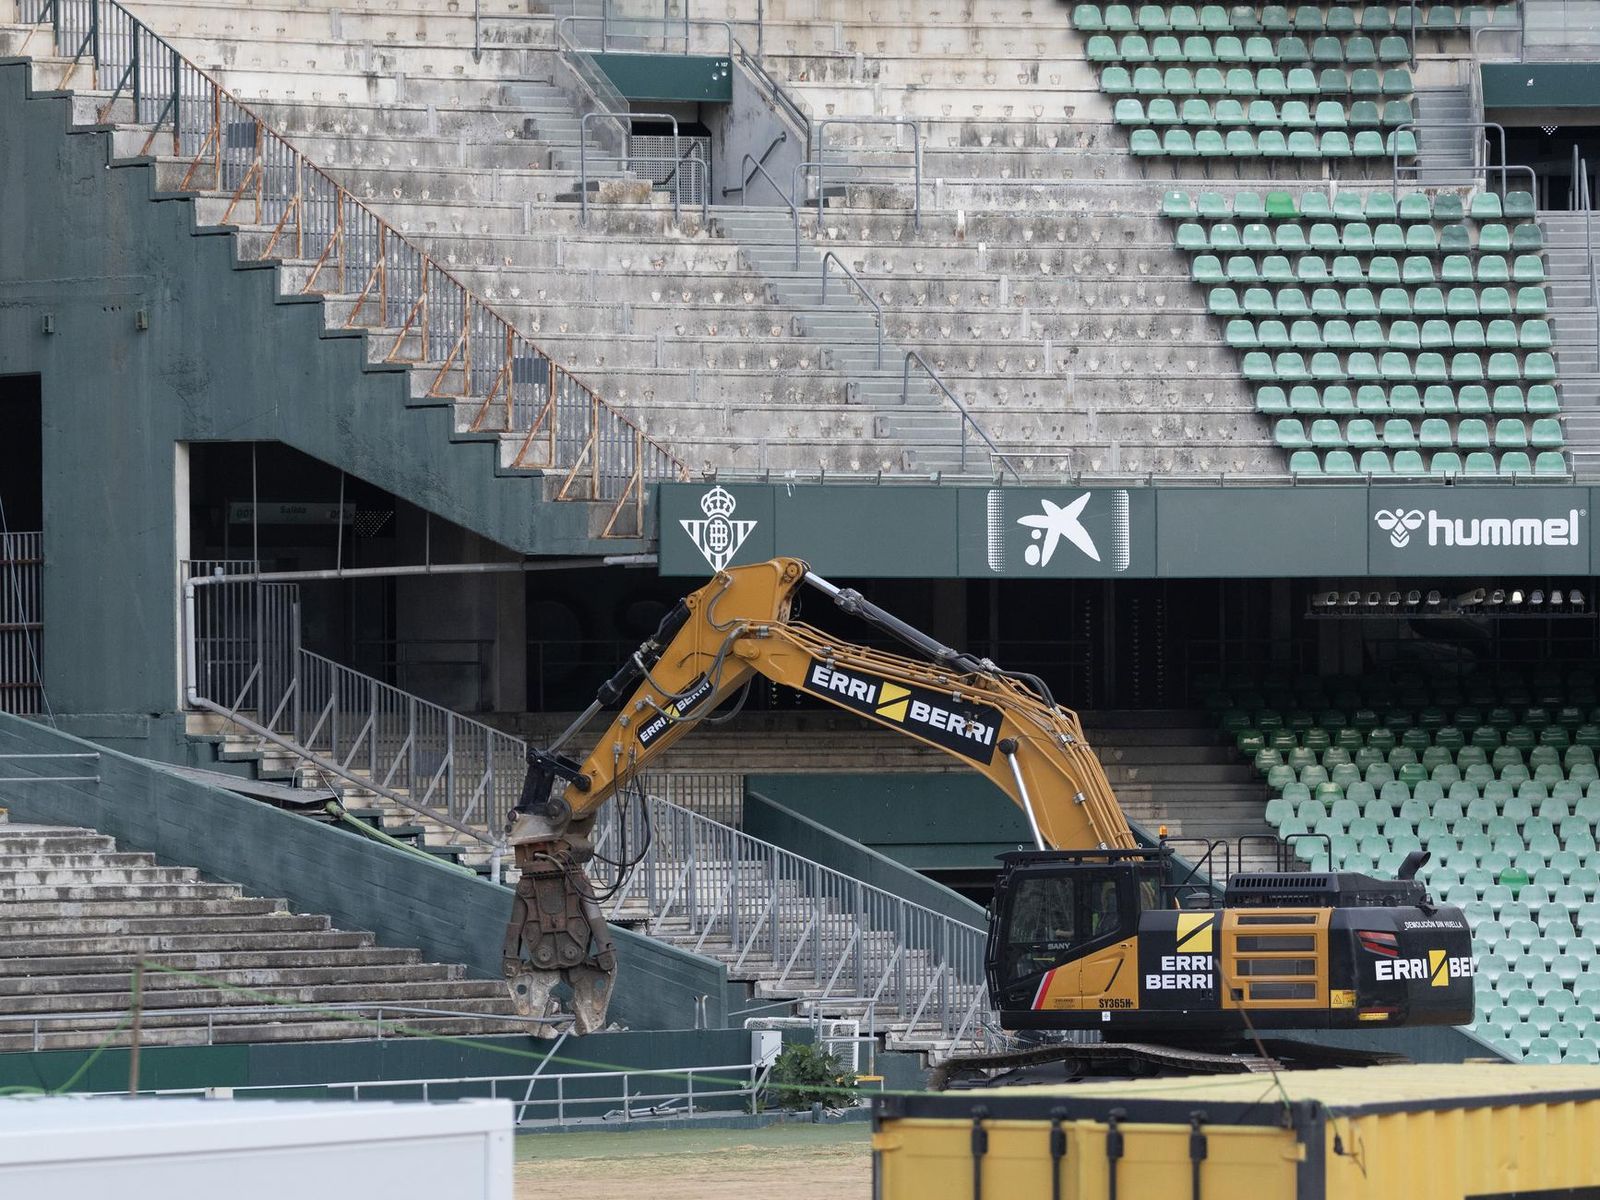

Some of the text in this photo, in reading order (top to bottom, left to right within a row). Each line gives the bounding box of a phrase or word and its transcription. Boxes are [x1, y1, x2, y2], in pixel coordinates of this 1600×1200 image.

[1428, 509, 1579, 546] hummel
[811, 665, 995, 746] ERRI BERRI
[640, 716, 667, 742] ERRI
[1047, 942, 1071, 950] SANY
[1161, 955, 1213, 971] ERRI
[1375, 958, 1428, 981] ERRI
[1146, 974, 1213, 989] BERRI
